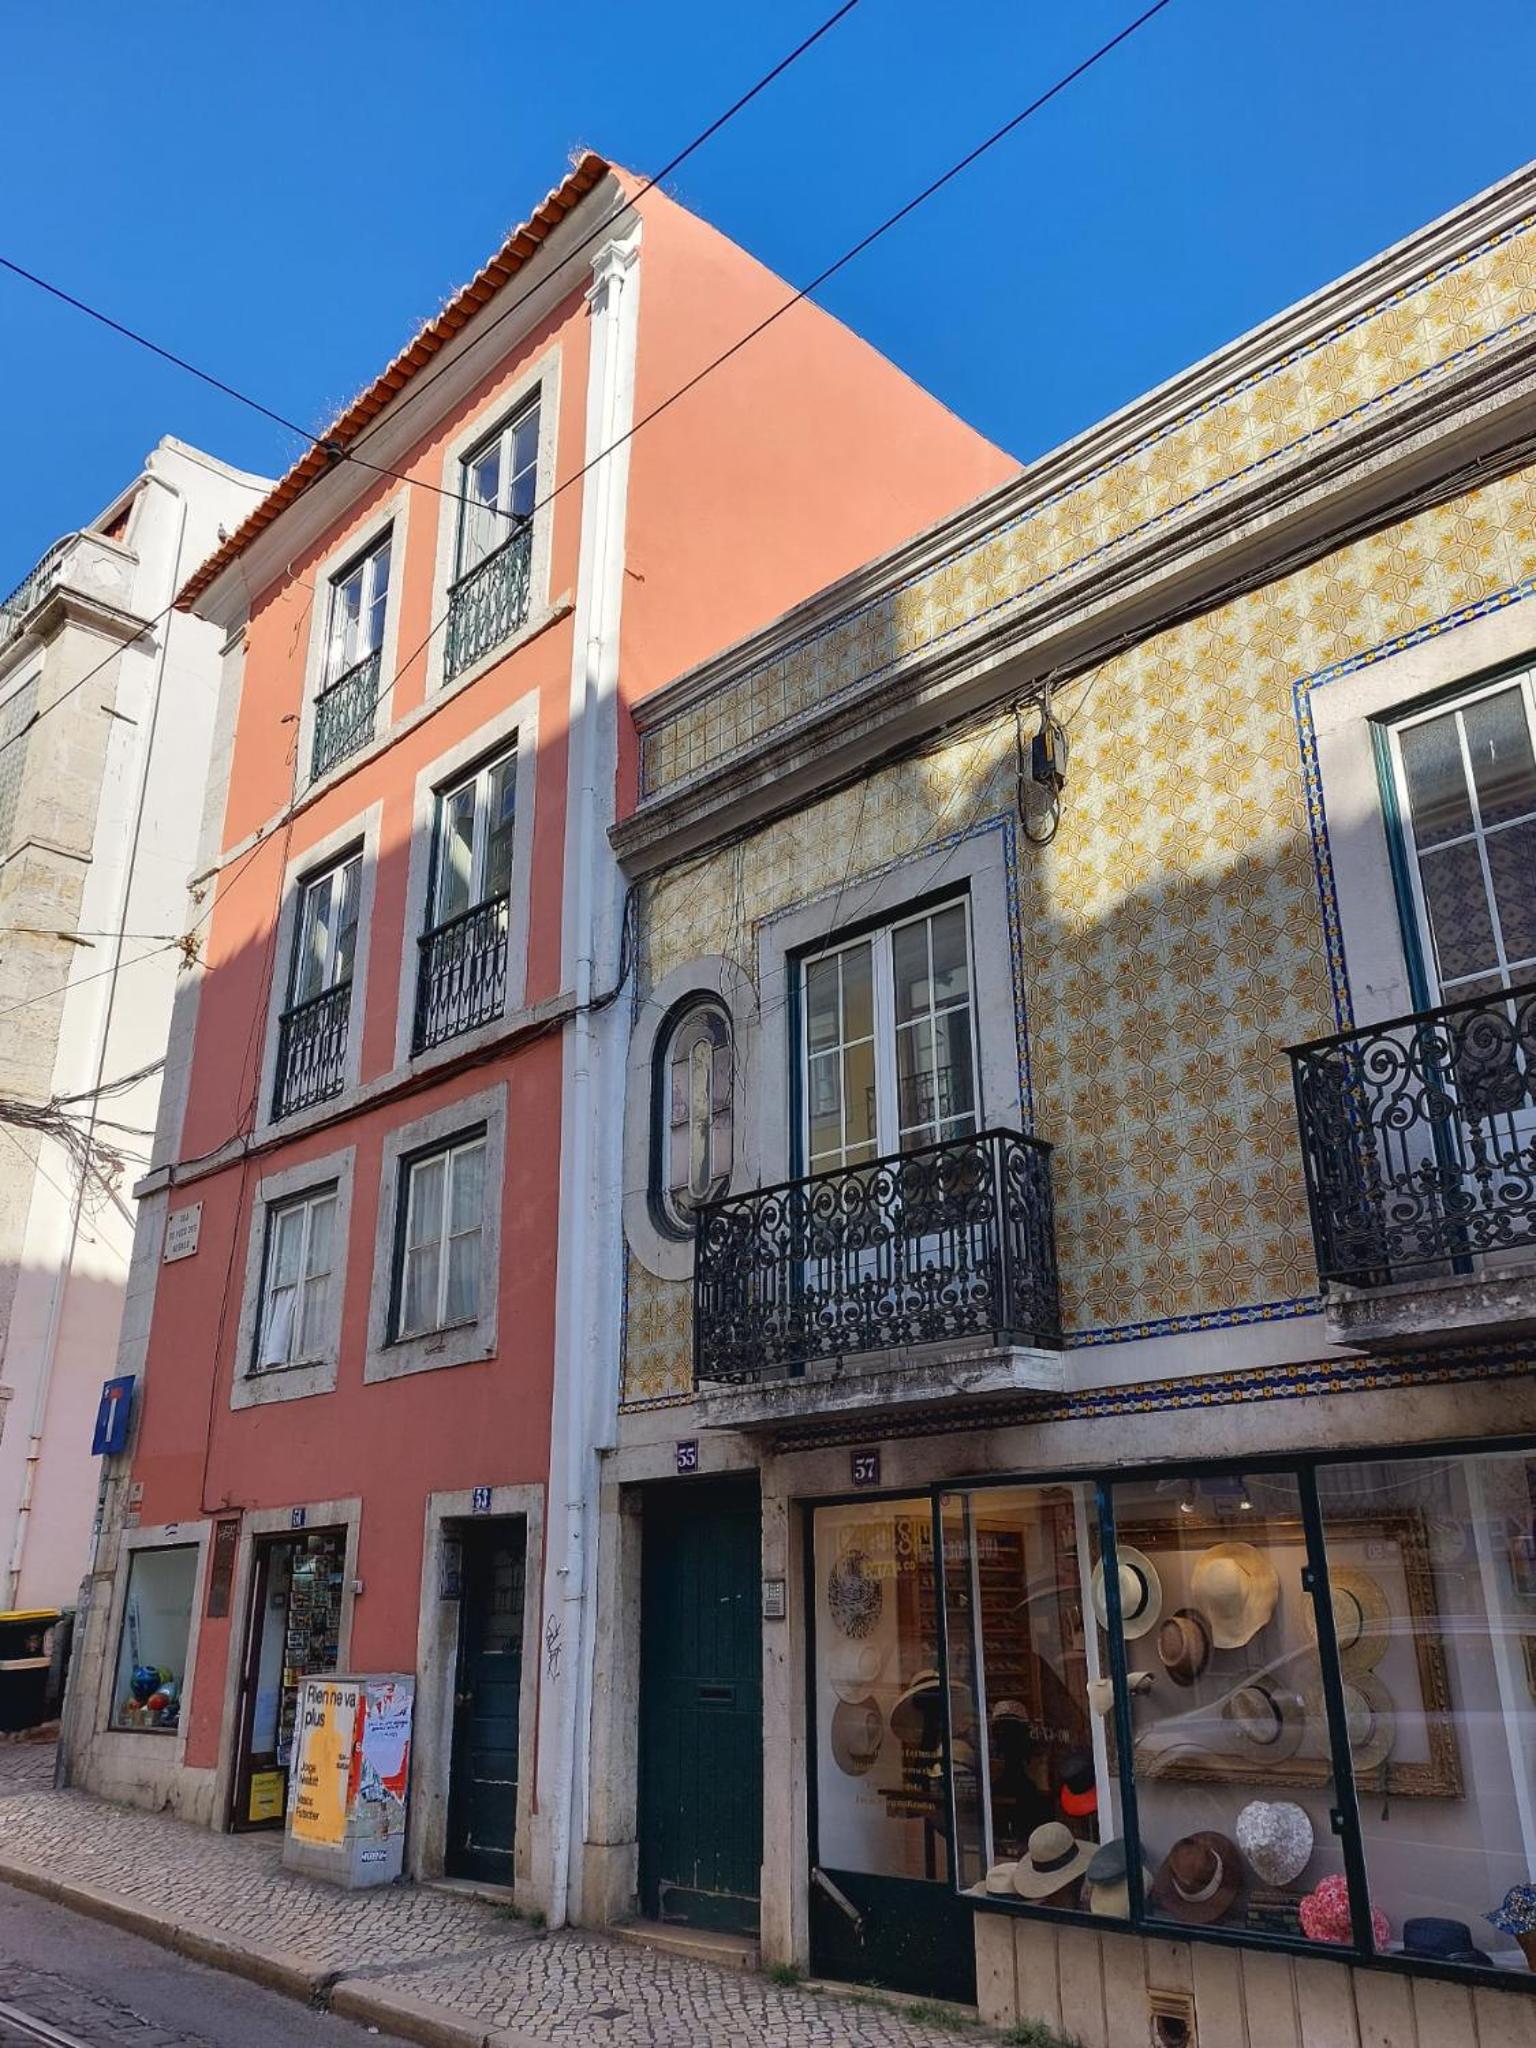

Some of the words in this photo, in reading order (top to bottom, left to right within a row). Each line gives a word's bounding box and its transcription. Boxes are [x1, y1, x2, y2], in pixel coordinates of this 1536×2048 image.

[677, 1448, 695, 1467] 55
[855, 1457, 875, 1480] 57
[475, 1489, 488, 1508] 53
[307, 1685, 328, 1704] Rien
[331, 1690, 343, 1706] ne
[344, 1692, 356, 1707] va
[305, 1707, 326, 1730] plus
